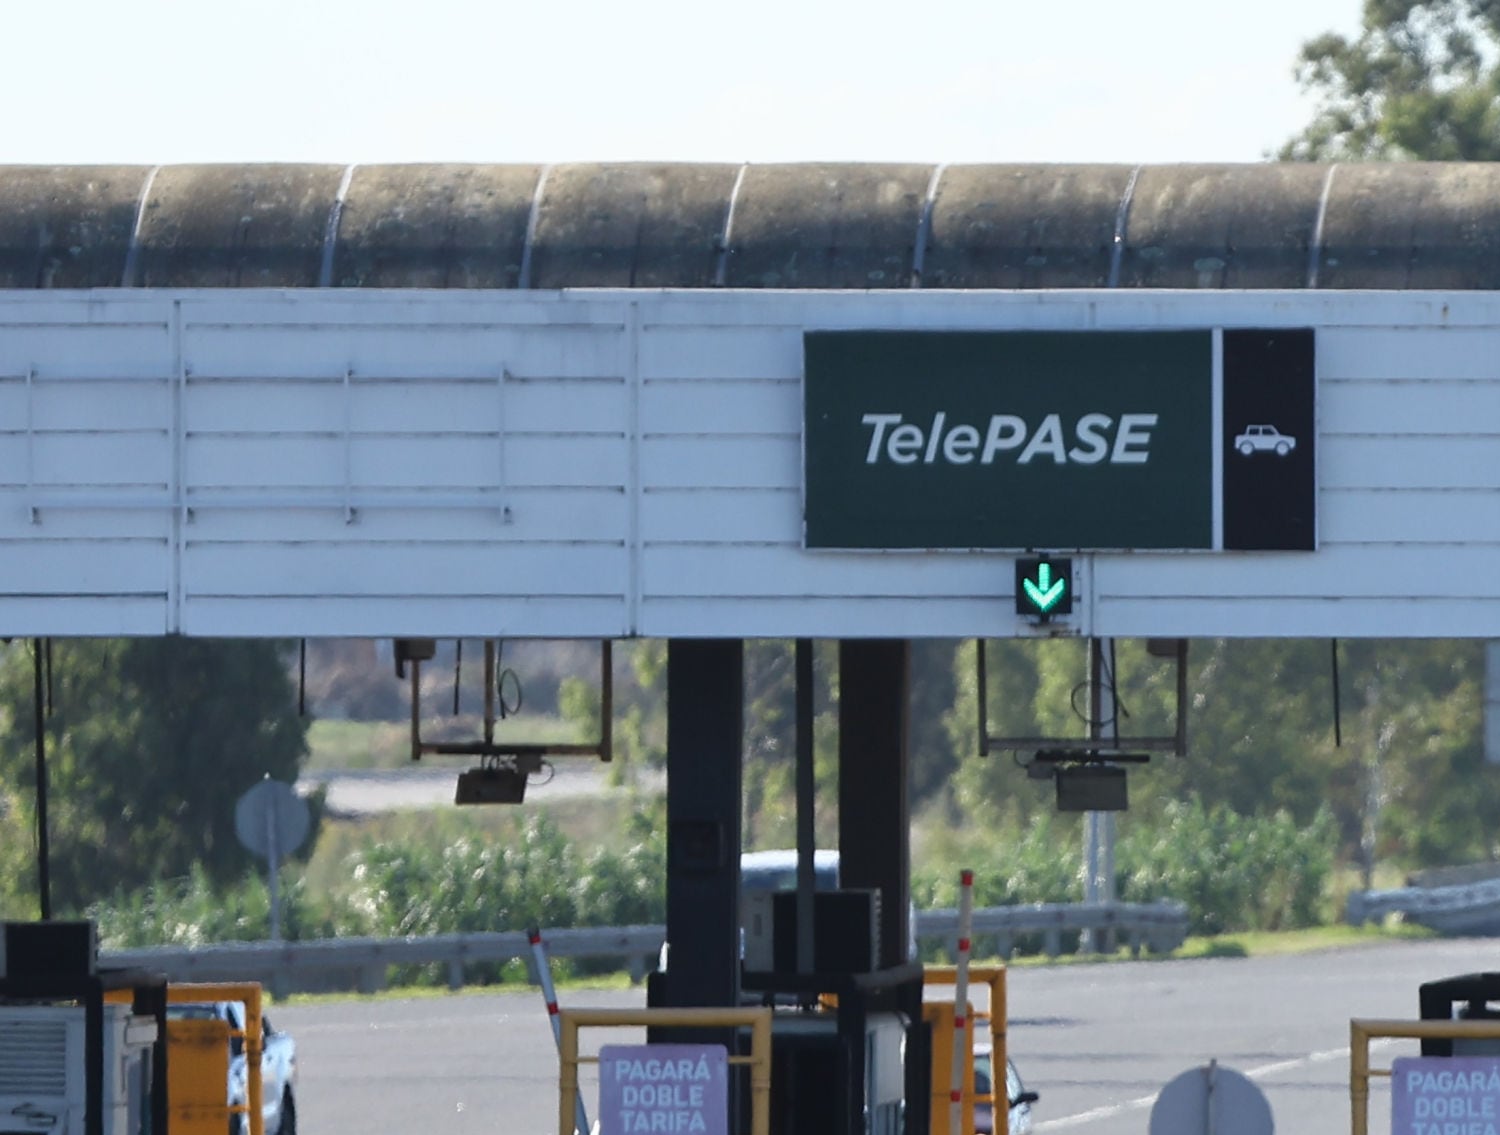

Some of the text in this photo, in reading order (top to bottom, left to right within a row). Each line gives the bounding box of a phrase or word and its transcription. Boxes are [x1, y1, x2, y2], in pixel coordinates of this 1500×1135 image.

[861, 411, 1159, 465] TelePASE
[615, 1053, 711, 1081] PAGARÁ
[622, 1085, 705, 1107] DOBLE
[1414, 1097, 1496, 1119] DOBLE
[619, 1111, 707, 1132] TARIFA
